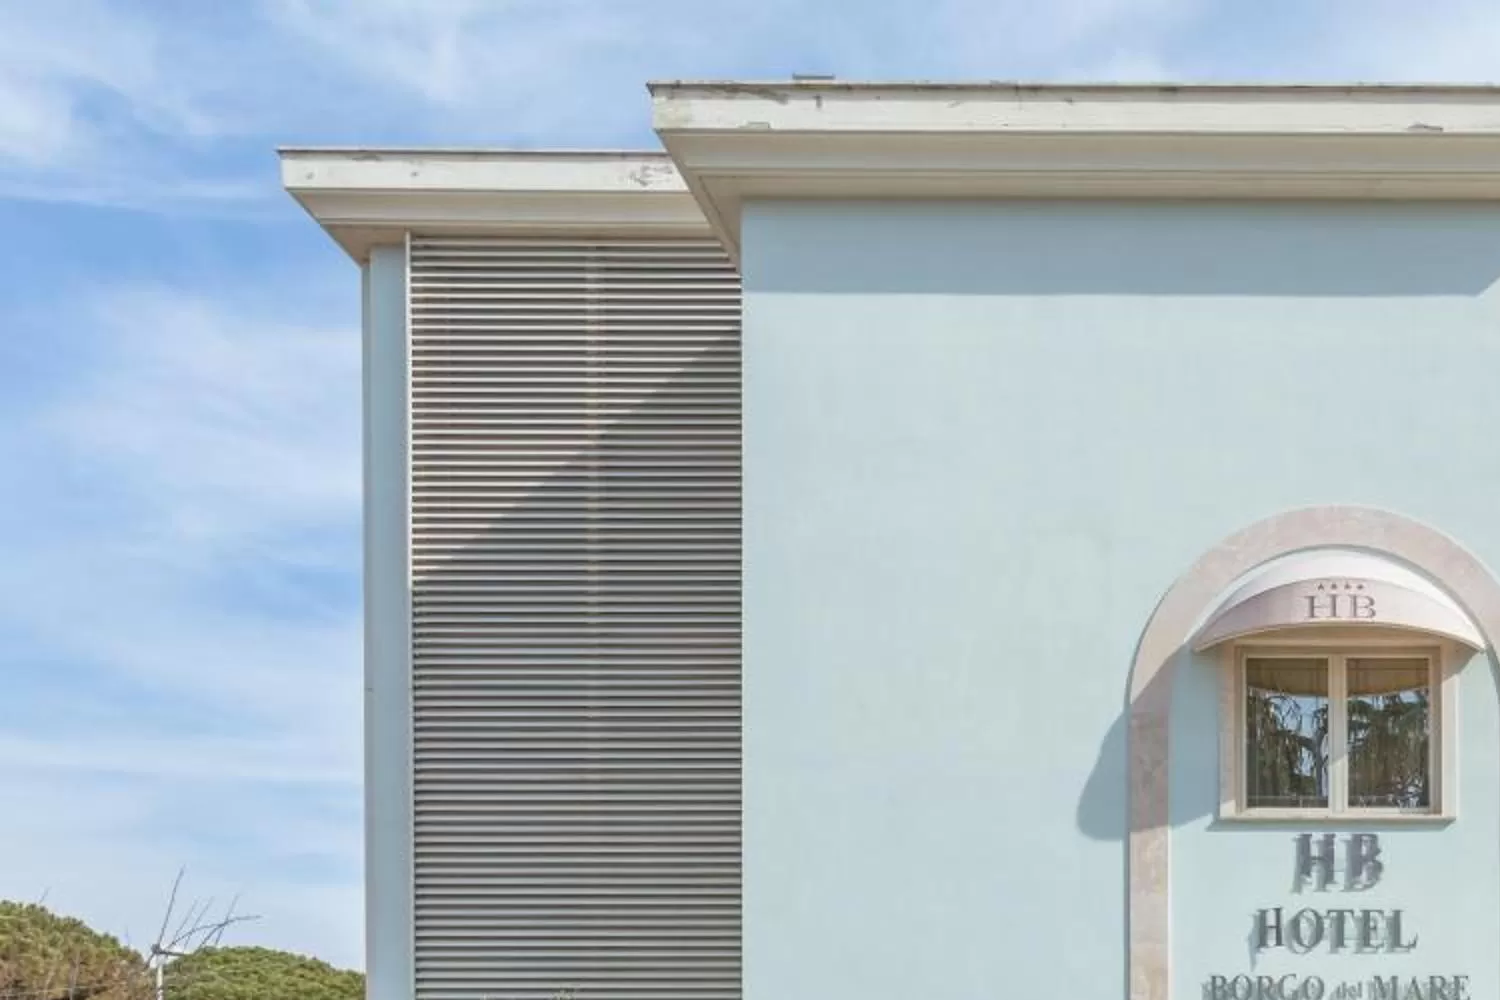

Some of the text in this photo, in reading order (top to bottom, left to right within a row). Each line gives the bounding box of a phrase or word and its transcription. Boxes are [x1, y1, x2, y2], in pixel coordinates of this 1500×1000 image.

[1303, 592, 1377, 619] HB
[1294, 833, 1384, 888] HB
[1255, 906, 1418, 950] HOTEL
[1334, 981, 1363, 1000] del
